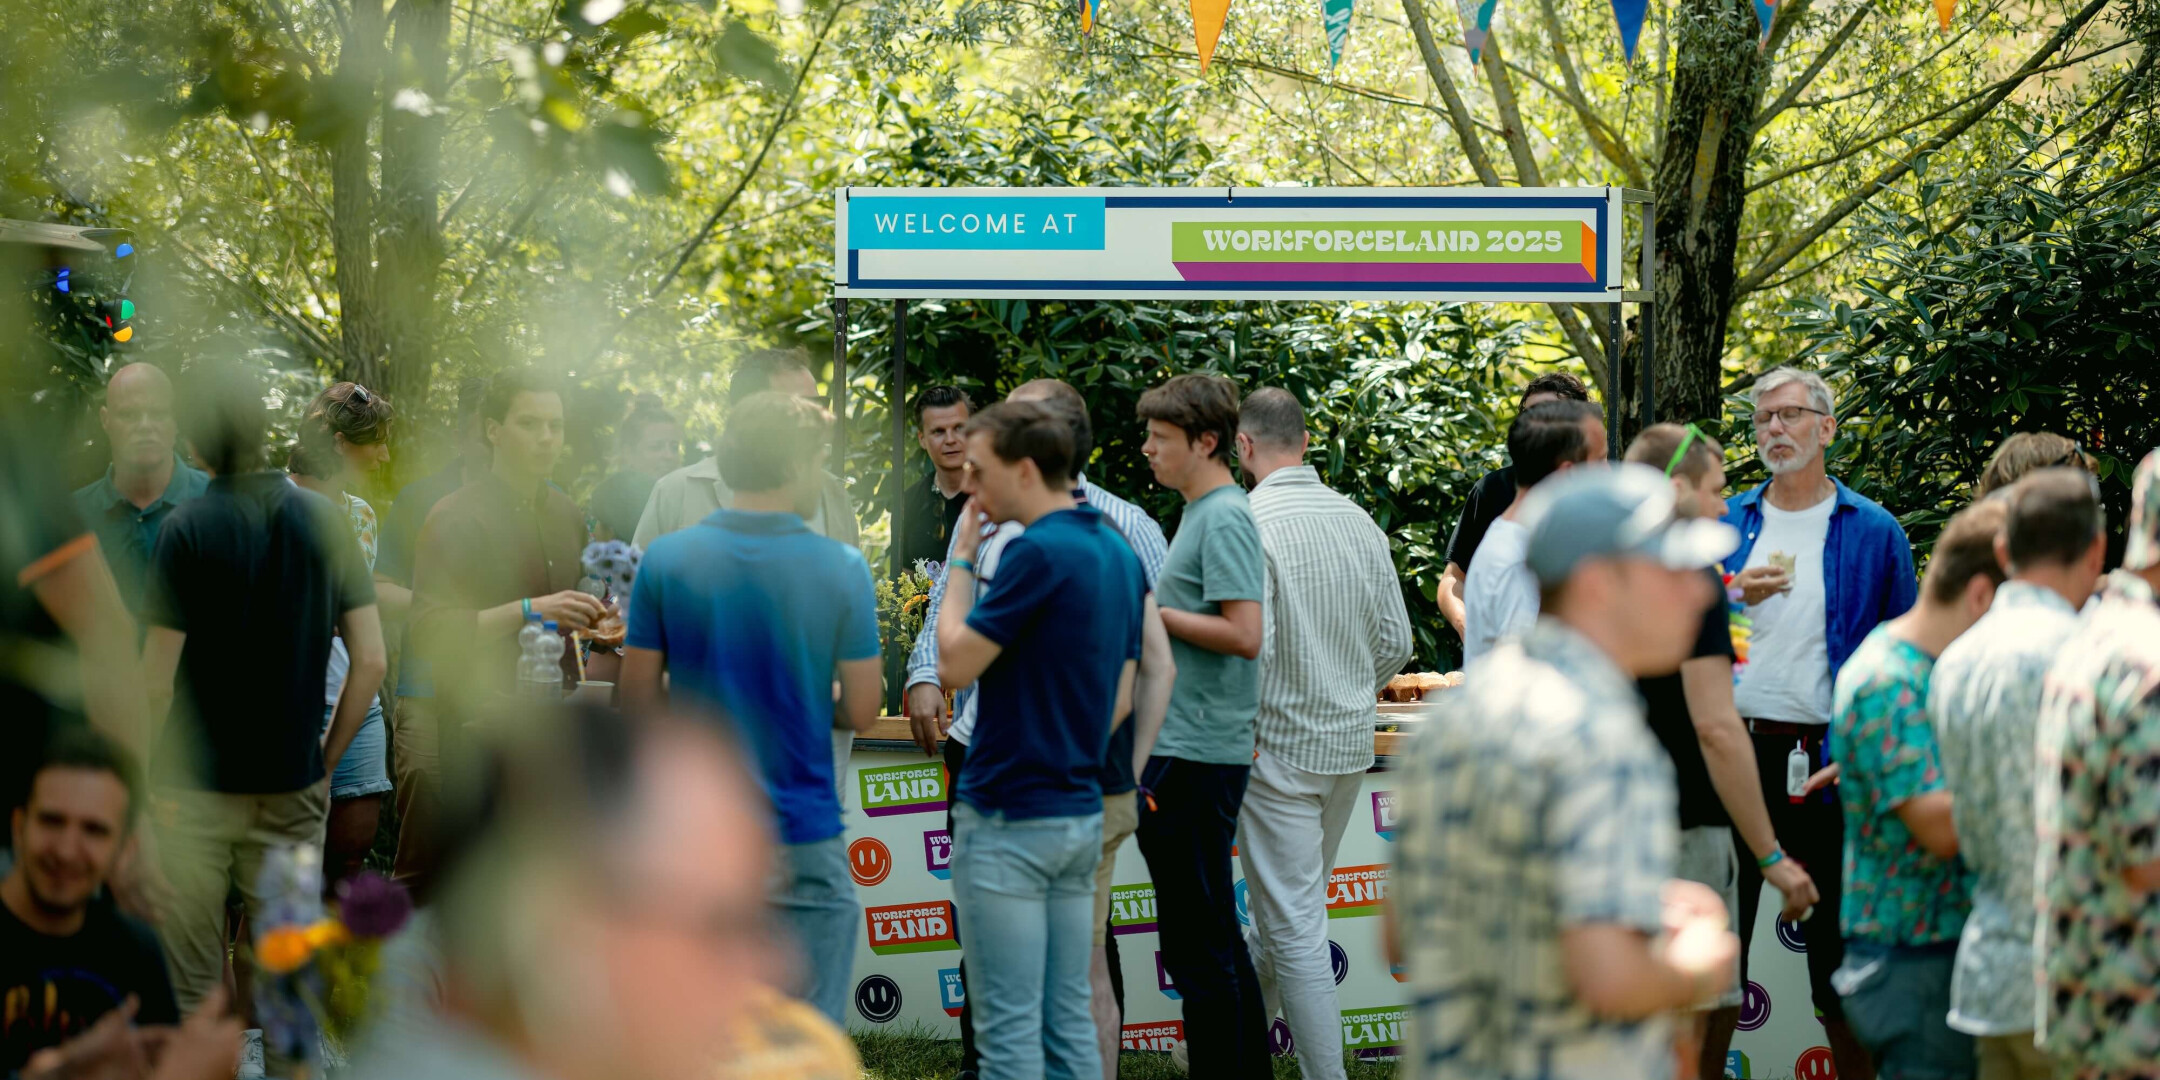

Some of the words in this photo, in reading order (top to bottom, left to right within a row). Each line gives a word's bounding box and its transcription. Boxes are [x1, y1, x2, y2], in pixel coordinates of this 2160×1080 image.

[874, 213, 1026, 234] WELCOME
[1041, 213, 1077, 234] AT
[1202, 229, 1480, 252] WORKFORCELAND
[1486, 229, 1563, 252] 2025
[864, 767, 938, 783] WORKFORCE
[866, 778, 940, 803] LAND
[1329, 869, 1392, 883] ORKFORCE
[1111, 888, 1155, 900] RKFOR
[871, 906, 945, 921] WORKFORCE
[873, 916, 948, 941] LAND
[1122, 1026, 1178, 1039] RKFORCE
[1122, 1036, 1178, 1051] AND
